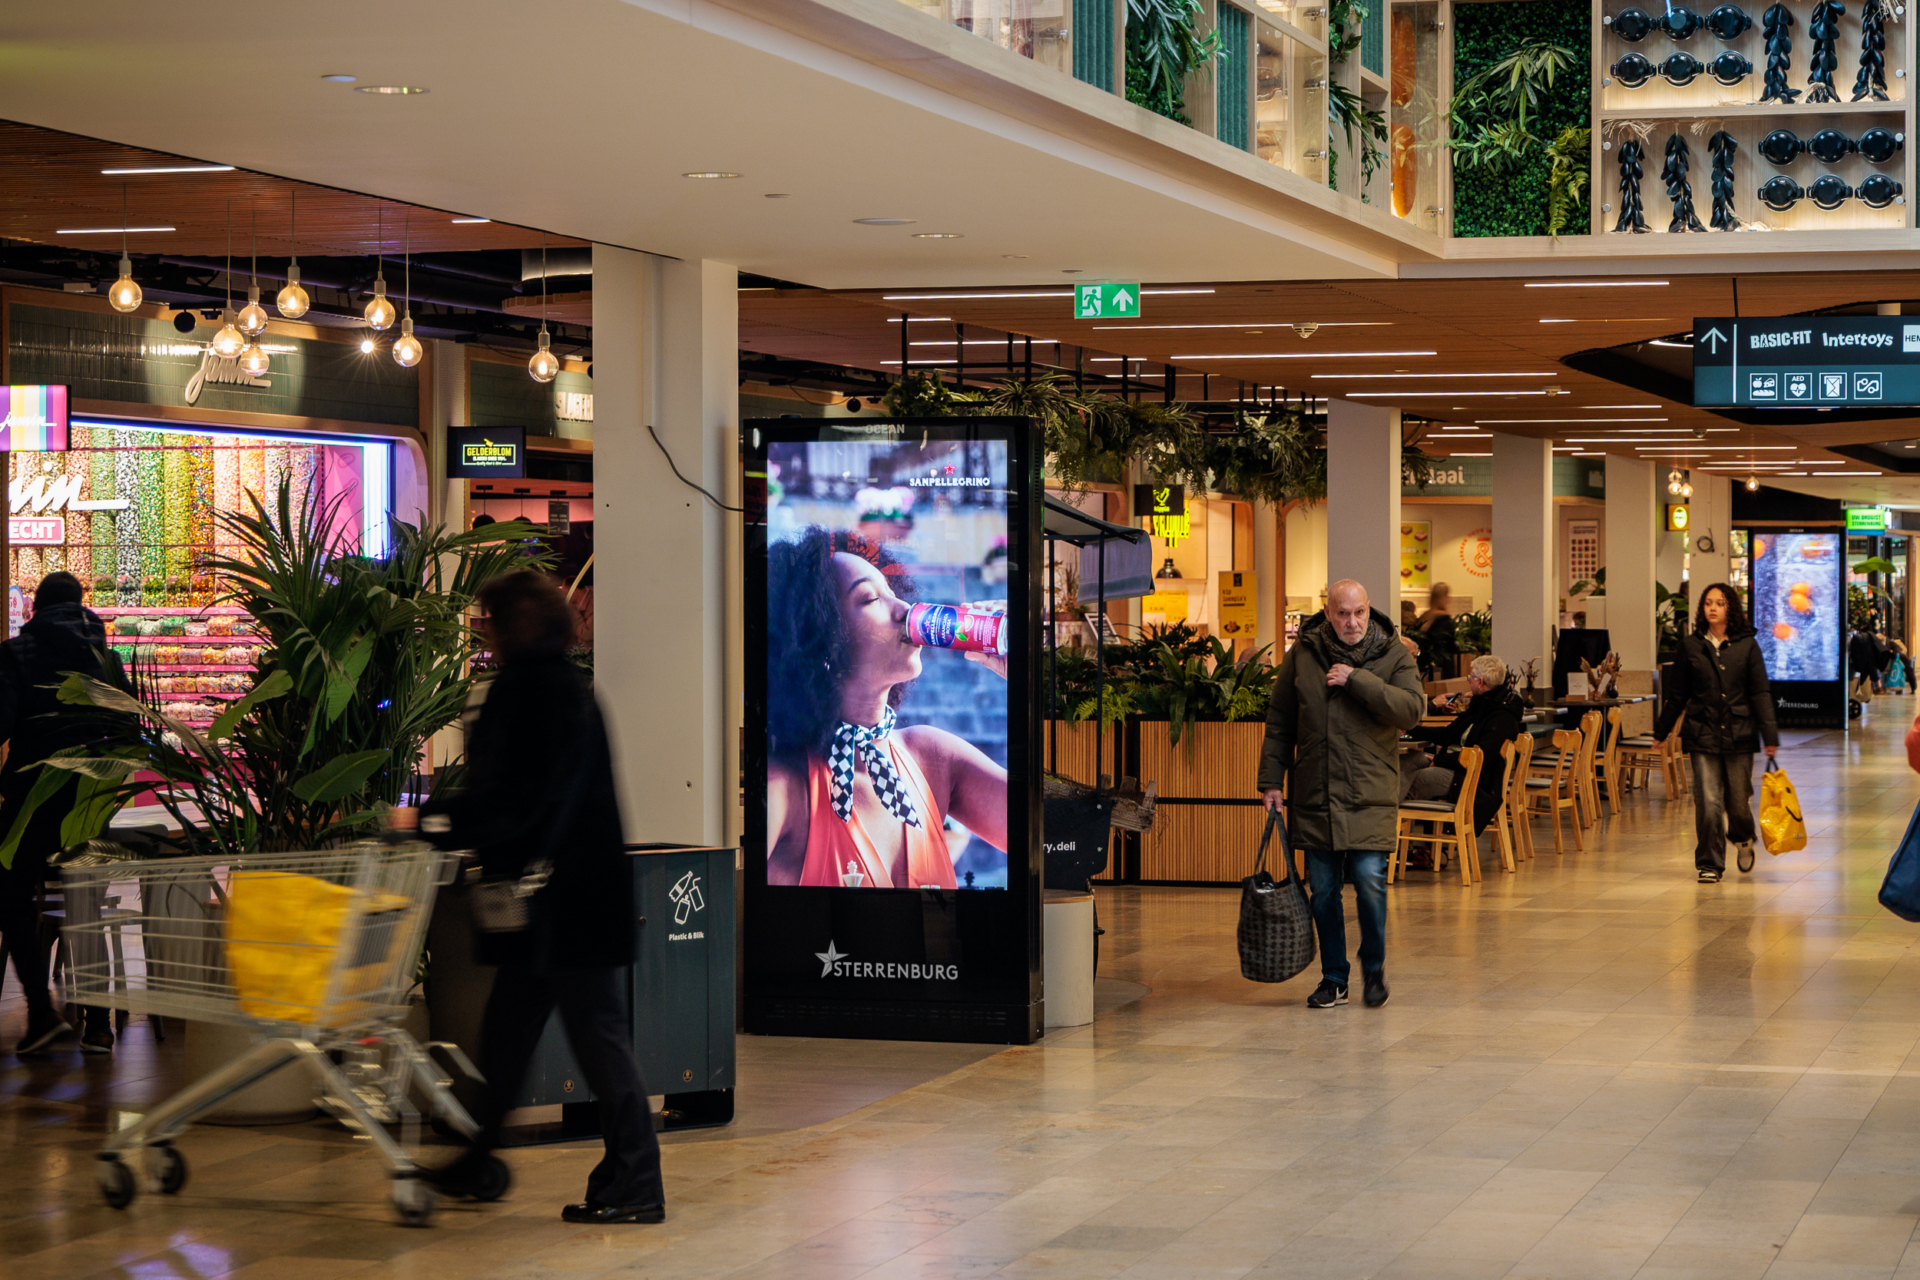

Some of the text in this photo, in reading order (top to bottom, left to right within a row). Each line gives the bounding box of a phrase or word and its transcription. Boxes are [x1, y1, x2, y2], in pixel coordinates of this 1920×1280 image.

[1750, 330, 1812, 349] BASIC-FIT
[1822, 332, 1894, 348] Intertoys
[0, 411, 58, 434] jamin
[865, 424, 905, 434] OCEAN
[466, 447, 512, 457] GELDERBLOM
[909, 477, 990, 487] SANPELLEGRINO
[9, 521, 56, 539] ECHT
[668, 931, 705, 941] Plastic & Blik
[833, 960, 959, 981] STERRENBURG
